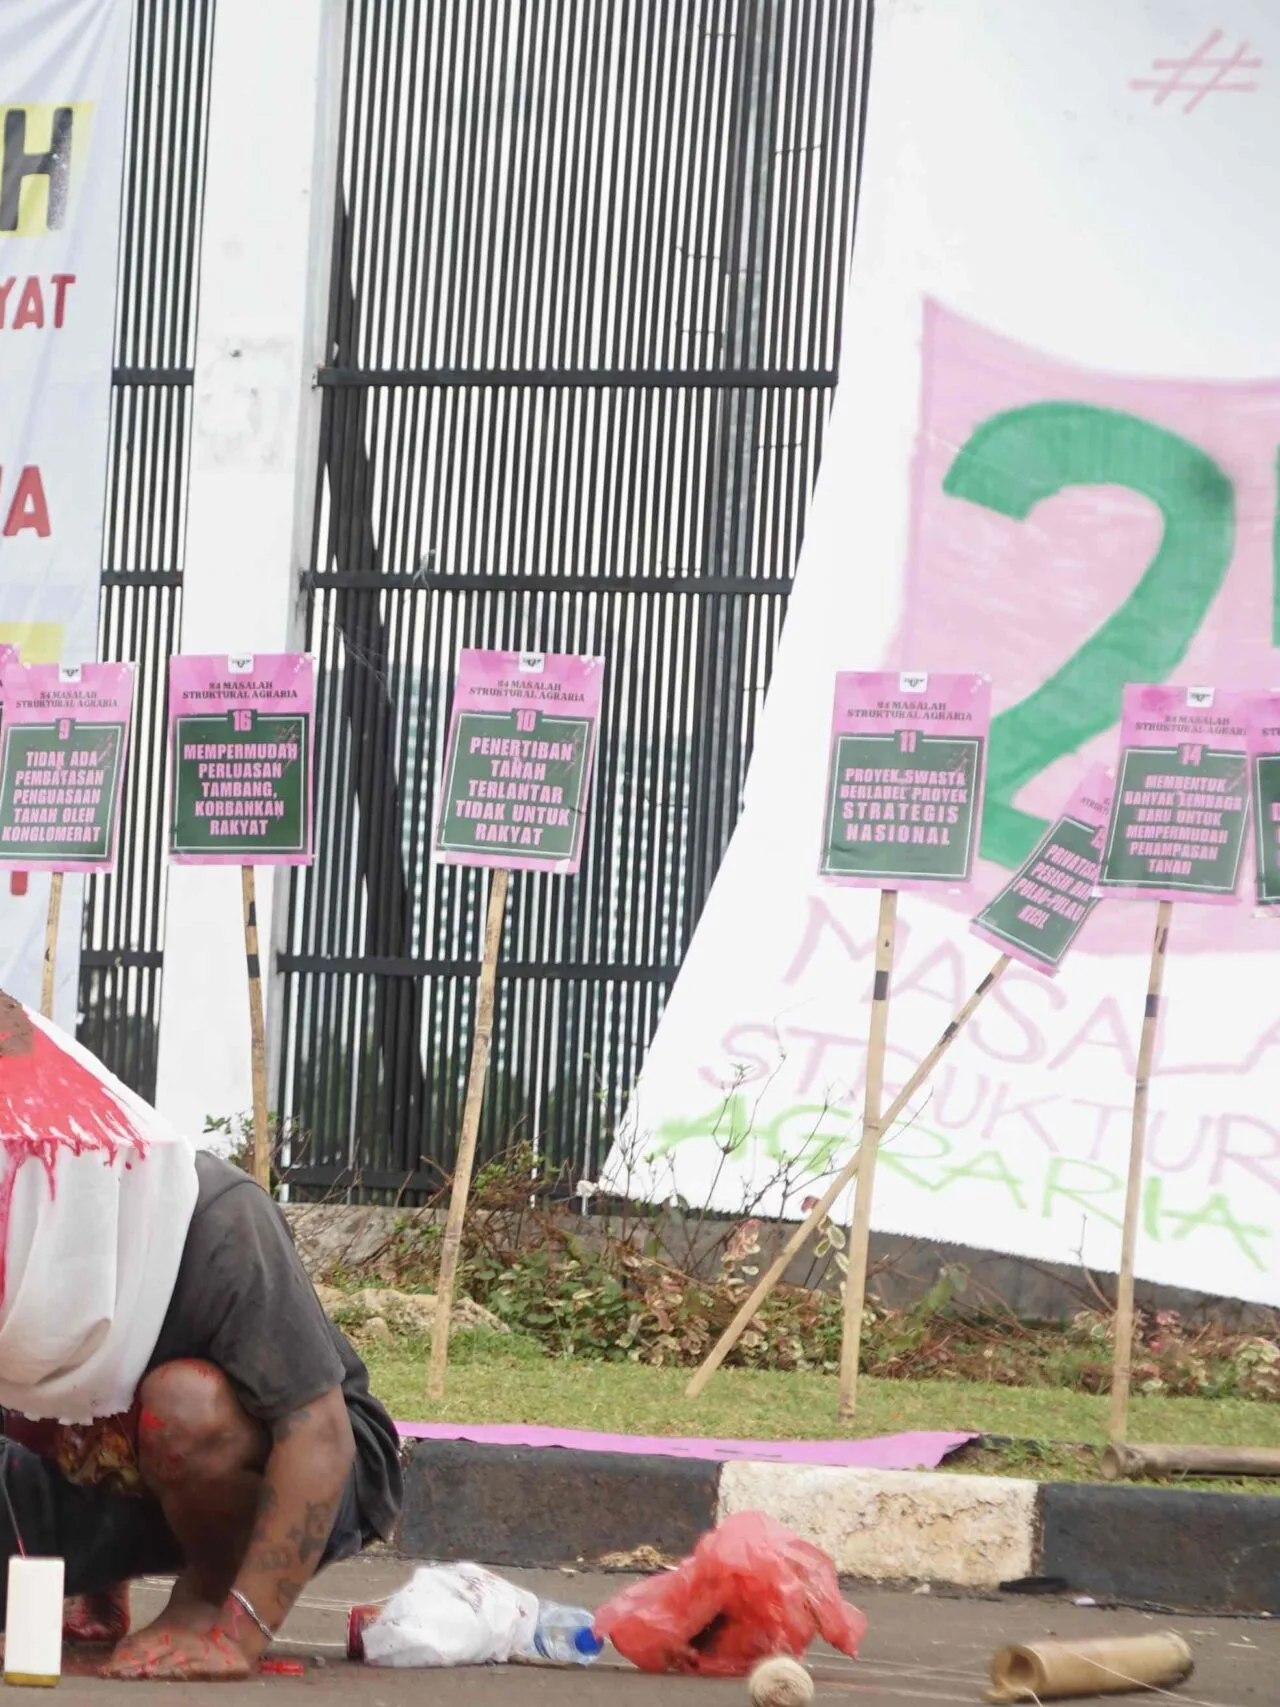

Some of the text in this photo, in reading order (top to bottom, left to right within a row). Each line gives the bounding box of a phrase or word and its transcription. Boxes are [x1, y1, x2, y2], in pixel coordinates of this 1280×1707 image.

[182, 689, 298, 699] STRUKTURAL AGRARIA
[222, 681, 273, 690] MASALAH
[469, 687, 585, 702] STRUKTURAL AGRARIA
[511, 680, 561, 691] MASALAH
[16, 700, 118, 709] STRUKTURAL AGRARIA
[51, 691, 97, 700] MASALAH
[847, 709, 973, 721] STRUKTURAL AGRARIA
[891, 701, 947, 711] MASALAH
[232, 710, 253, 732] 16
[1135, 722, 1205, 733] STRUKTURAL
[470, 736, 573, 762] PENERTIBAN
[899, 731, 916, 753] 11
[26, 751, 98, 767] TIDAK ADA
[183, 743, 298, 761] MEMPERMUDAH
[14, 769, 104, 787] PEMBATASAN
[198, 762, 282, 779] PERLUASAN
[490, 759, 547, 781] TANAH
[845, 767, 966, 786] PROYEK SWASTA
[201, 782, 278, 799] TAMBANG,
[468, 780, 564, 804] TERLANTAR
[1144, 775, 1228, 793] MEMBENTUK
[12, 788, 101, 805] PENGUASAAN
[840, 784, 969, 804] BERLABEL PROYEK
[1124, 790, 1174, 806] BANYAK
[13, 806, 95, 824] TANAH OLEH
[195, 800, 285, 818] KORBANKAN
[455, 799, 571, 827] TIDAK UNTUK
[843, 801, 960, 824] STRATEGIS
[1136, 808, 1223, 826] BARU UNTUK
[1, 826, 101, 843] KONGLOMERAT
[209, 819, 269, 836] RAKYAT
[475, 823, 544, 846] RAKYAT
[846, 823, 950, 845] NASIONAL
[1126, 824, 1229, 844] MEMPERMUDAH
[1129, 841, 1219, 860] PERAMPASAN
[1030, 861, 1075, 892] PESISIR
[1148, 859, 1192, 876] TANAH
[654, 1092, 1272, 1273] AGRARIA
